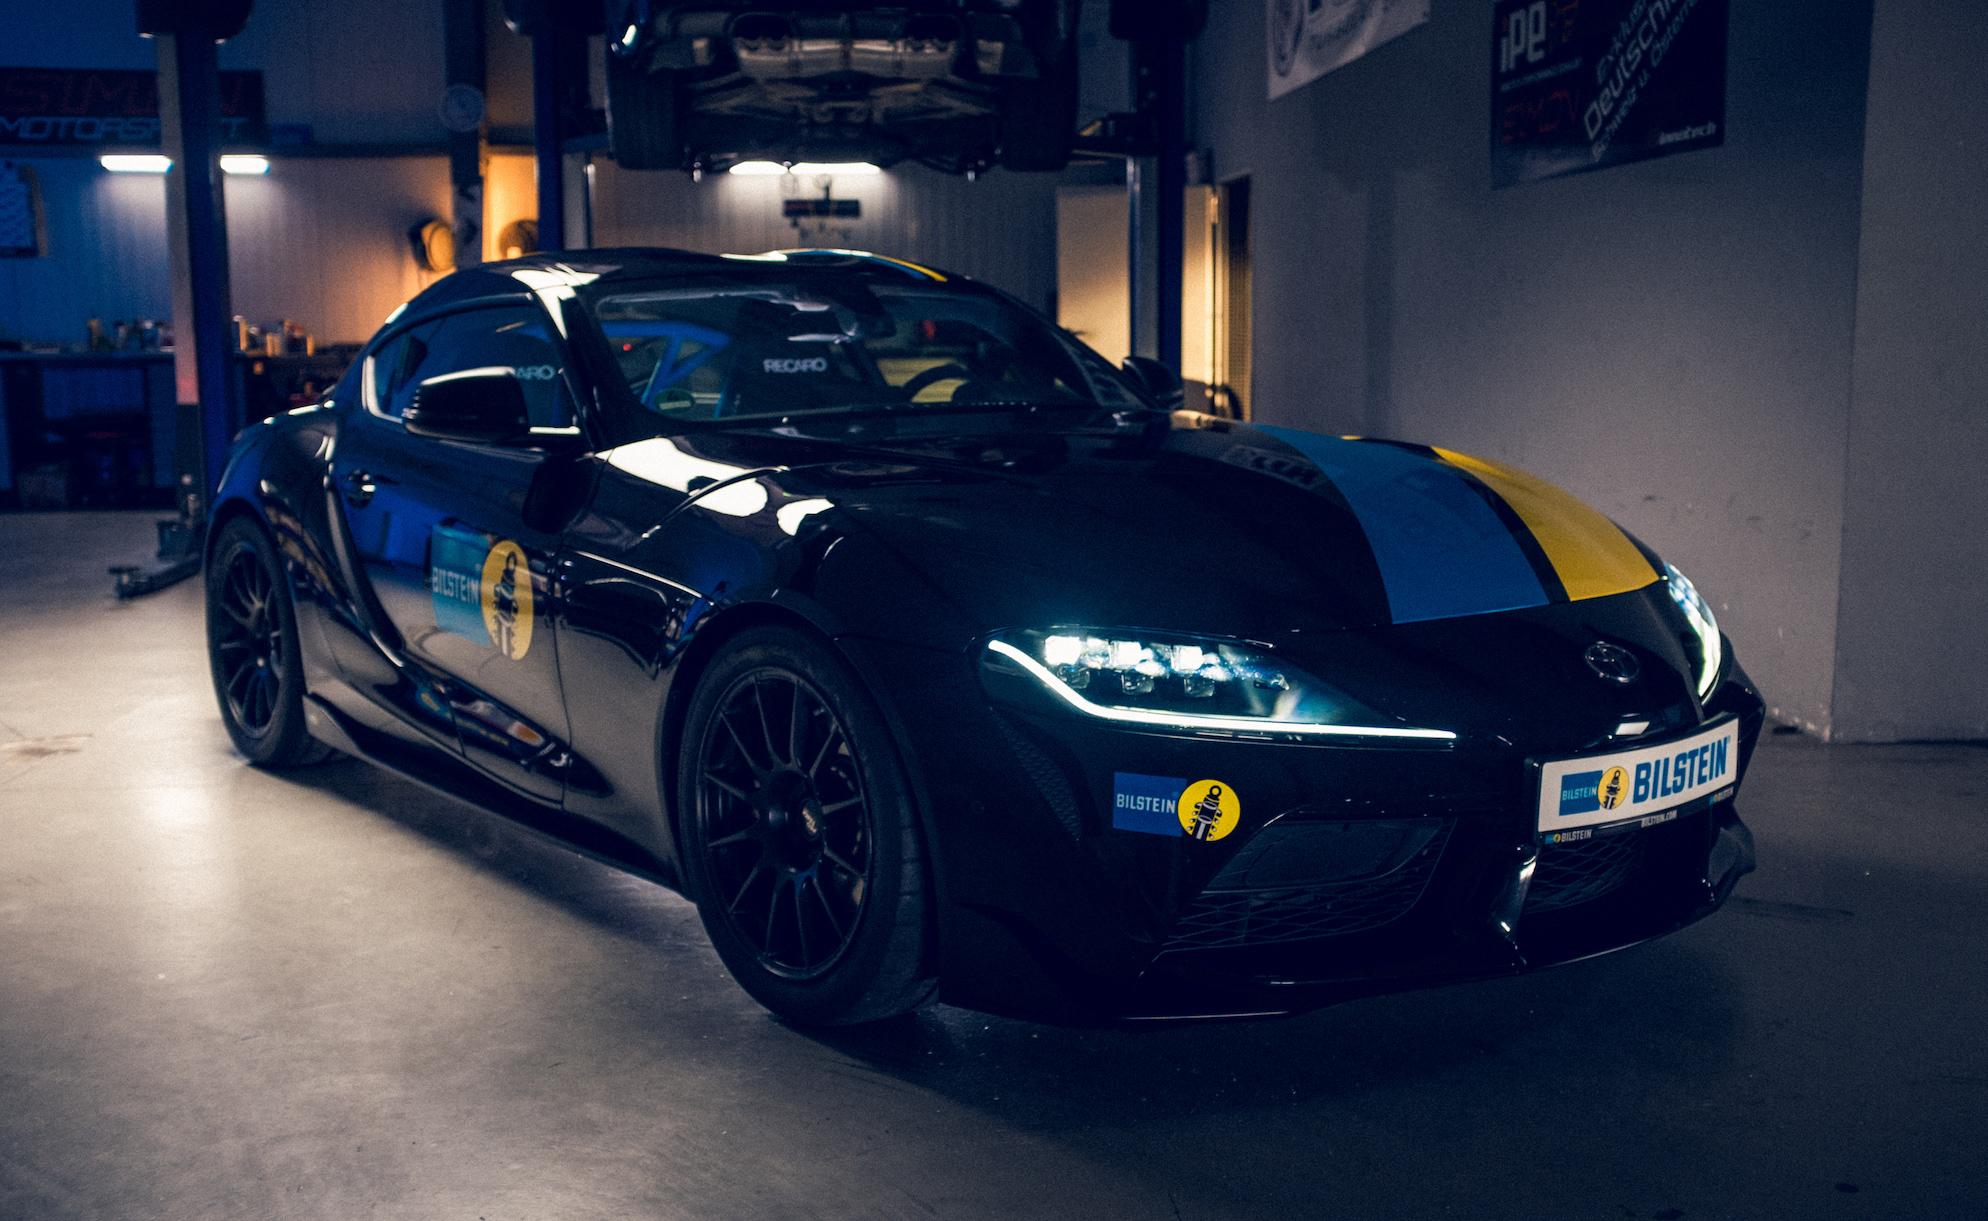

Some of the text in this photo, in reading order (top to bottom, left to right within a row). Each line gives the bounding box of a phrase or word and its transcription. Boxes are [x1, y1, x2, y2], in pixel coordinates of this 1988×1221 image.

[763, 357, 828, 374] RECARO
[432, 567, 479, 605] BILSTEIN
[1562, 737, 1728, 804] BILSTEIN BILSTEIN
[1116, 793, 1176, 814] BILSTEIN
[1561, 829, 1592, 842] BILSTEIN
